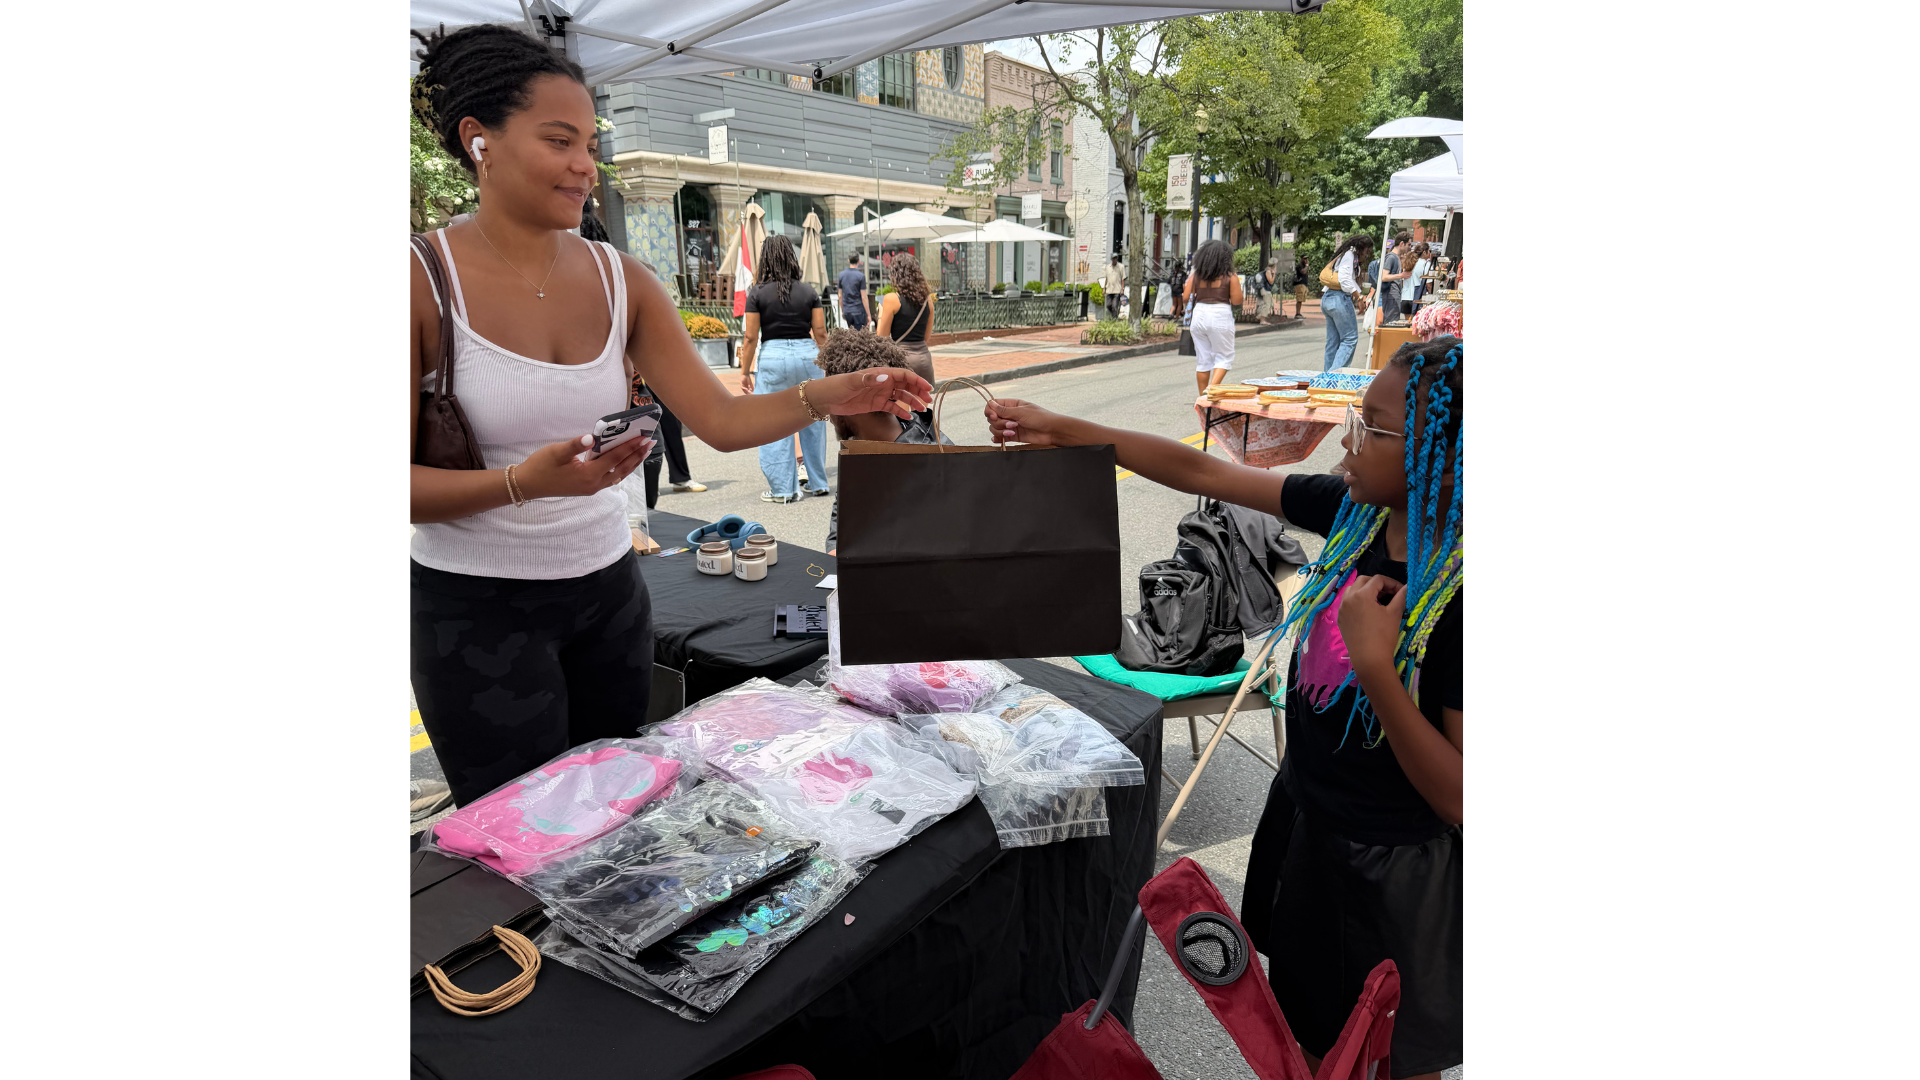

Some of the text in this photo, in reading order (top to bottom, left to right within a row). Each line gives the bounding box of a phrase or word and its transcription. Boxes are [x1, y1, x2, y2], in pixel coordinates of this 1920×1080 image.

[1180, 159, 1188, 187] CHEERS
[1172, 176, 1180, 187] 150
[1154, 588, 1177, 596] adidas
